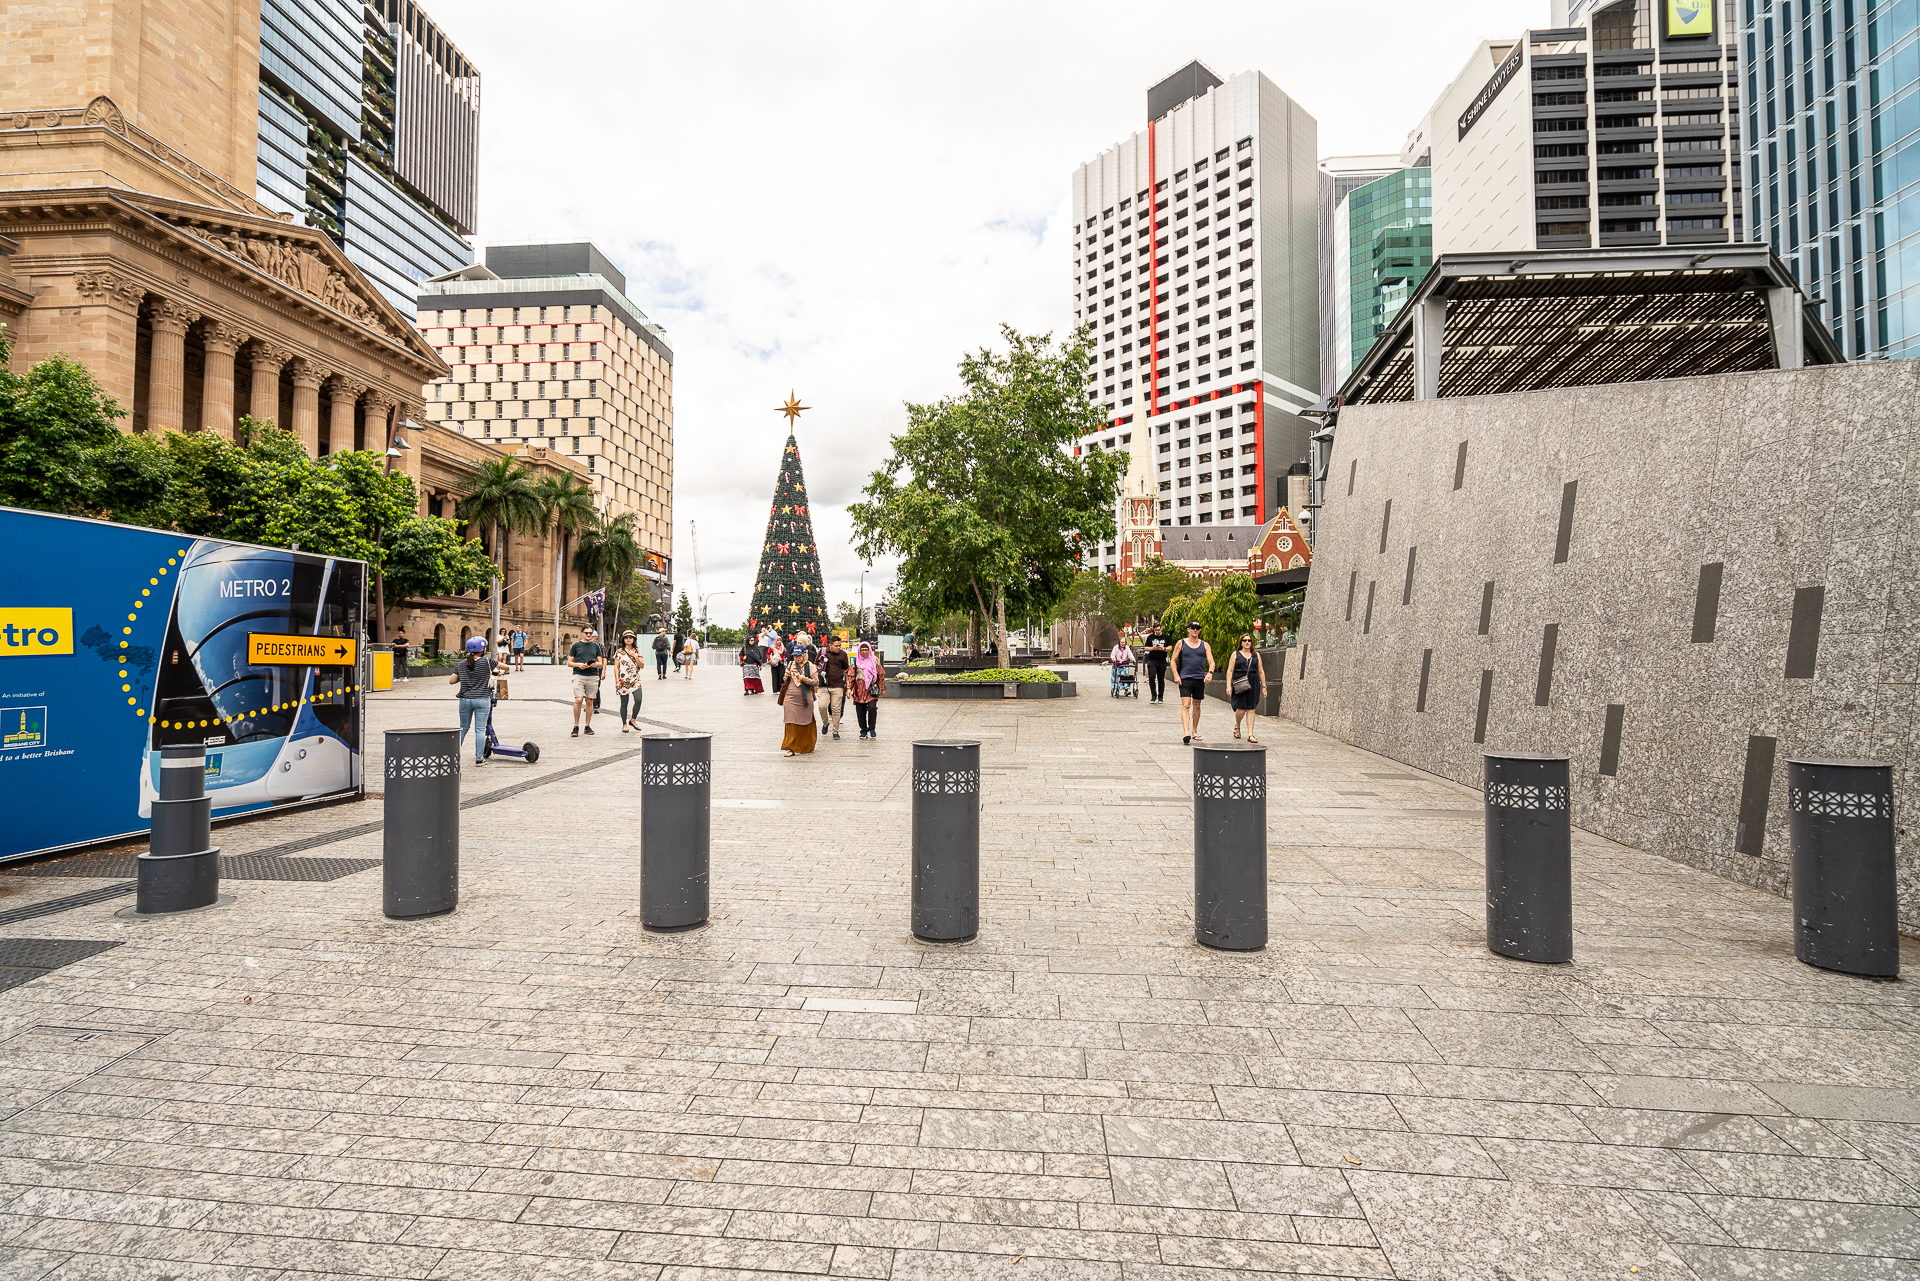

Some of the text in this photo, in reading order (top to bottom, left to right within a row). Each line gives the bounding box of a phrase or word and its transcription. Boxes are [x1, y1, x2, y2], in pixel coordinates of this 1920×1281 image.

[1467, 52, 1520, 124] SHINE LAWYERS
[220, 578, 291, 598] METRO 2
[0, 623, 59, 647] tro
[256, 642, 326, 657] PEDESTRIANS
[21, 752, 42, 760] better
[44, 749, 75, 758] Brisbane
